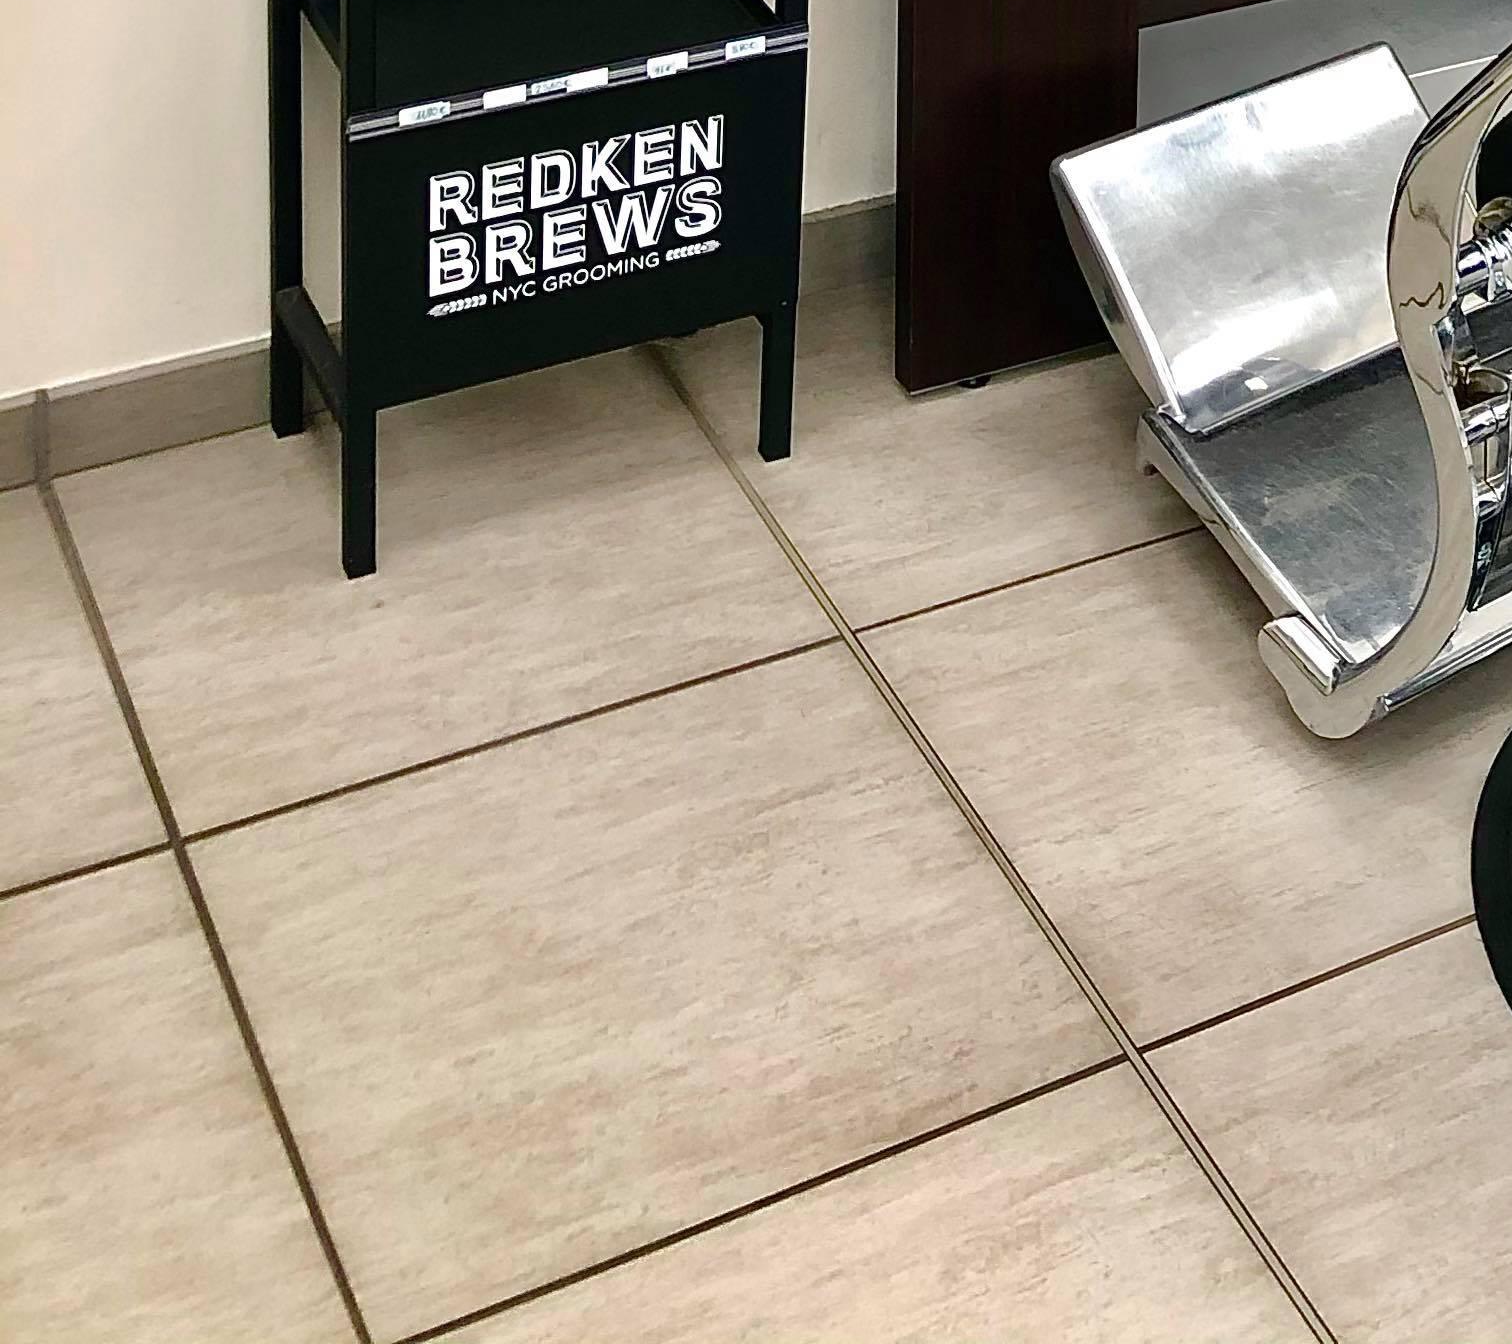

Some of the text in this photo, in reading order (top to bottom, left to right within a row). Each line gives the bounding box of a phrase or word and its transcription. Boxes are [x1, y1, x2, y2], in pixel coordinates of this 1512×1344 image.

[429, 114, 725, 233] REDKEN
[429, 175, 723, 298] BREWS
[491, 251, 661, 306] NYC GROOMING
